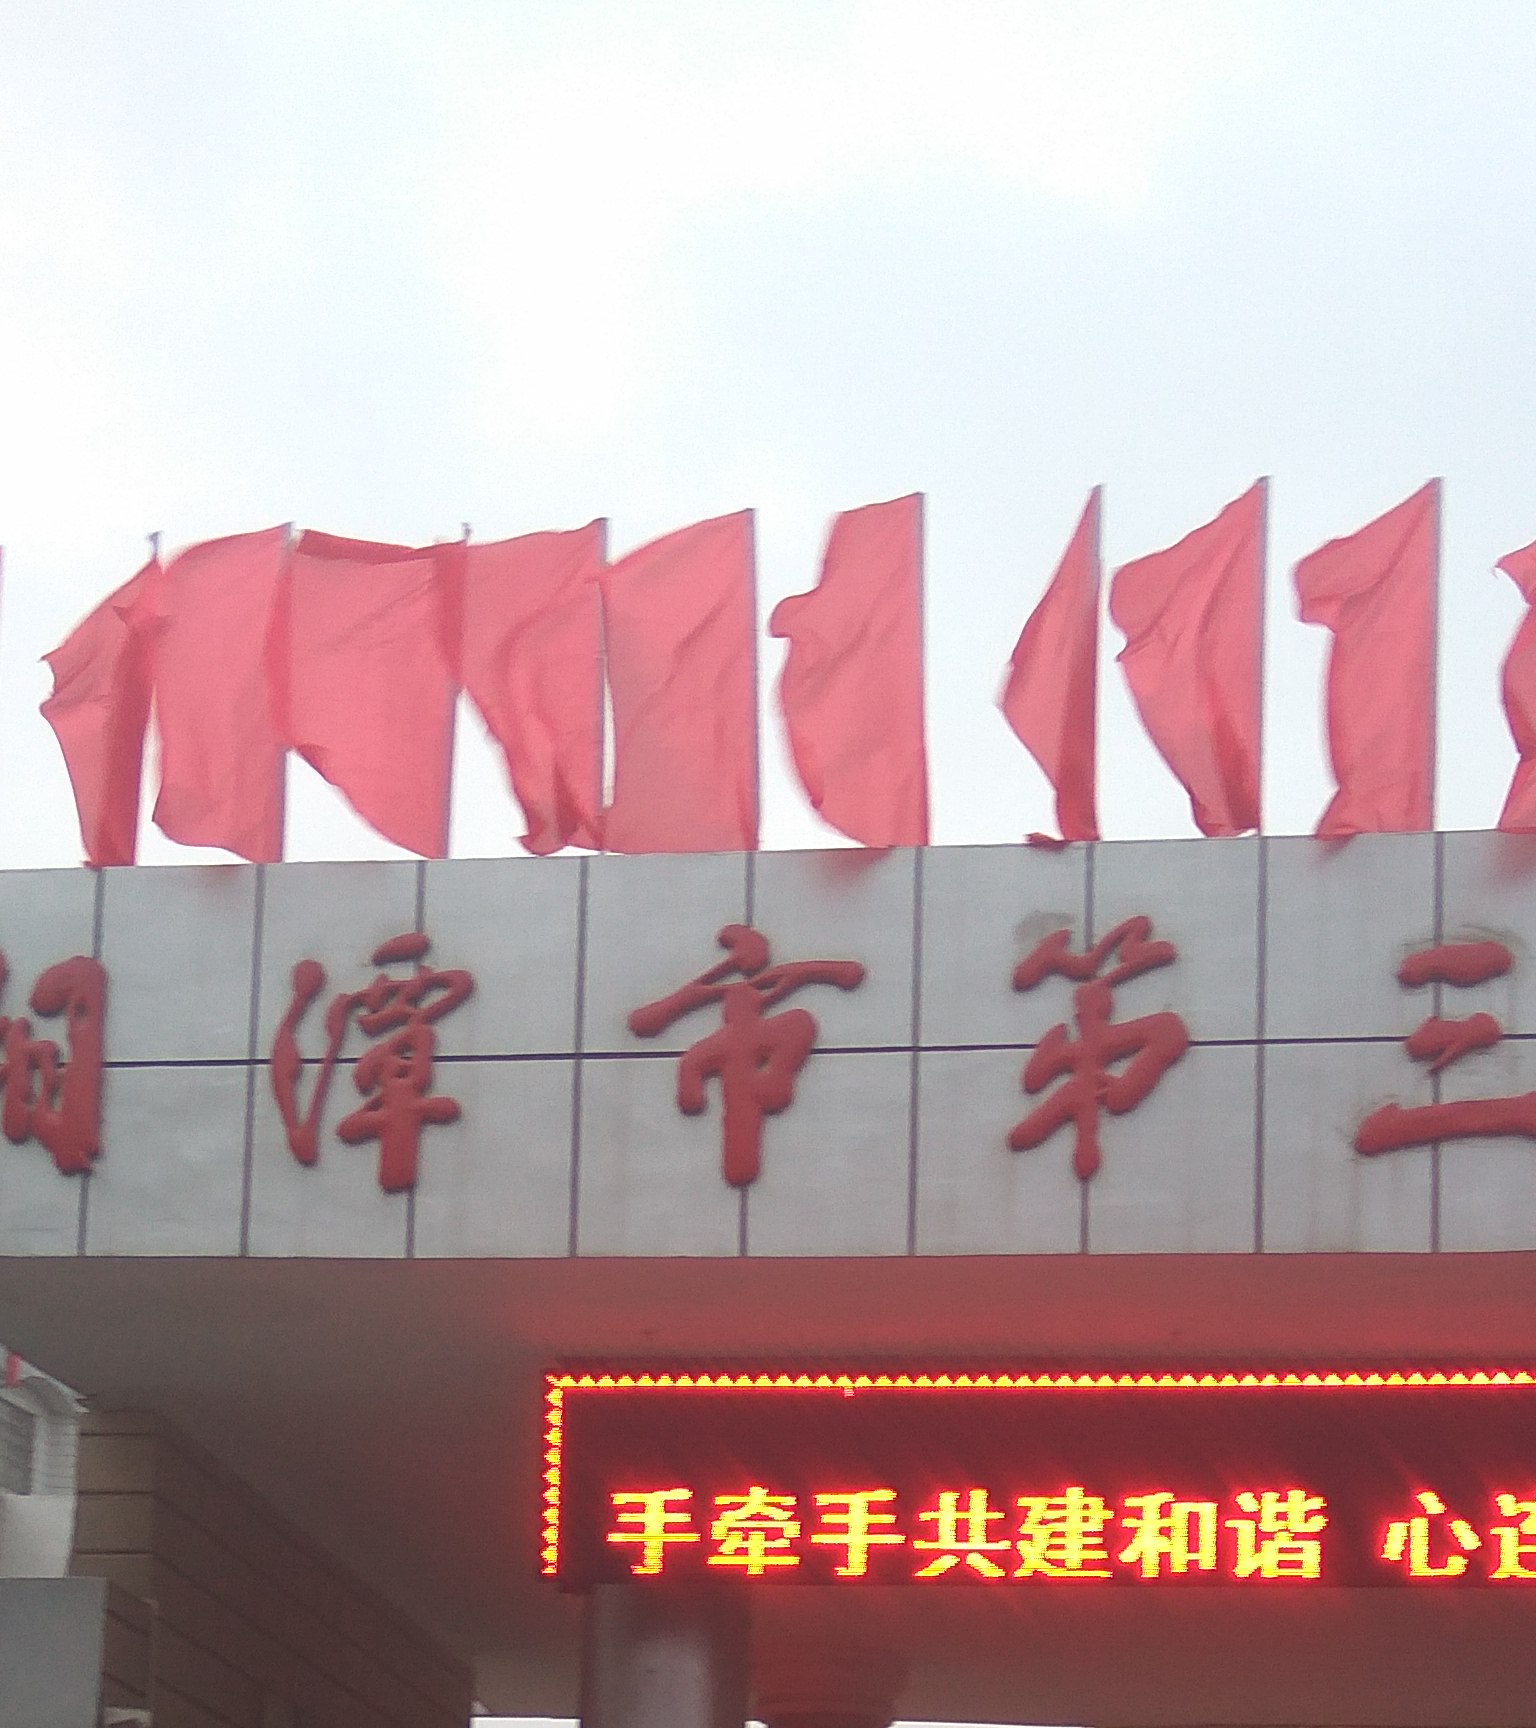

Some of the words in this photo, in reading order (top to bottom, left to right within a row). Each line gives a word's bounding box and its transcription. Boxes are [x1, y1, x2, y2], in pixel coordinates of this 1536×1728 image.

[606, 1485, 1329, 1580] 手牵手共建和谐
